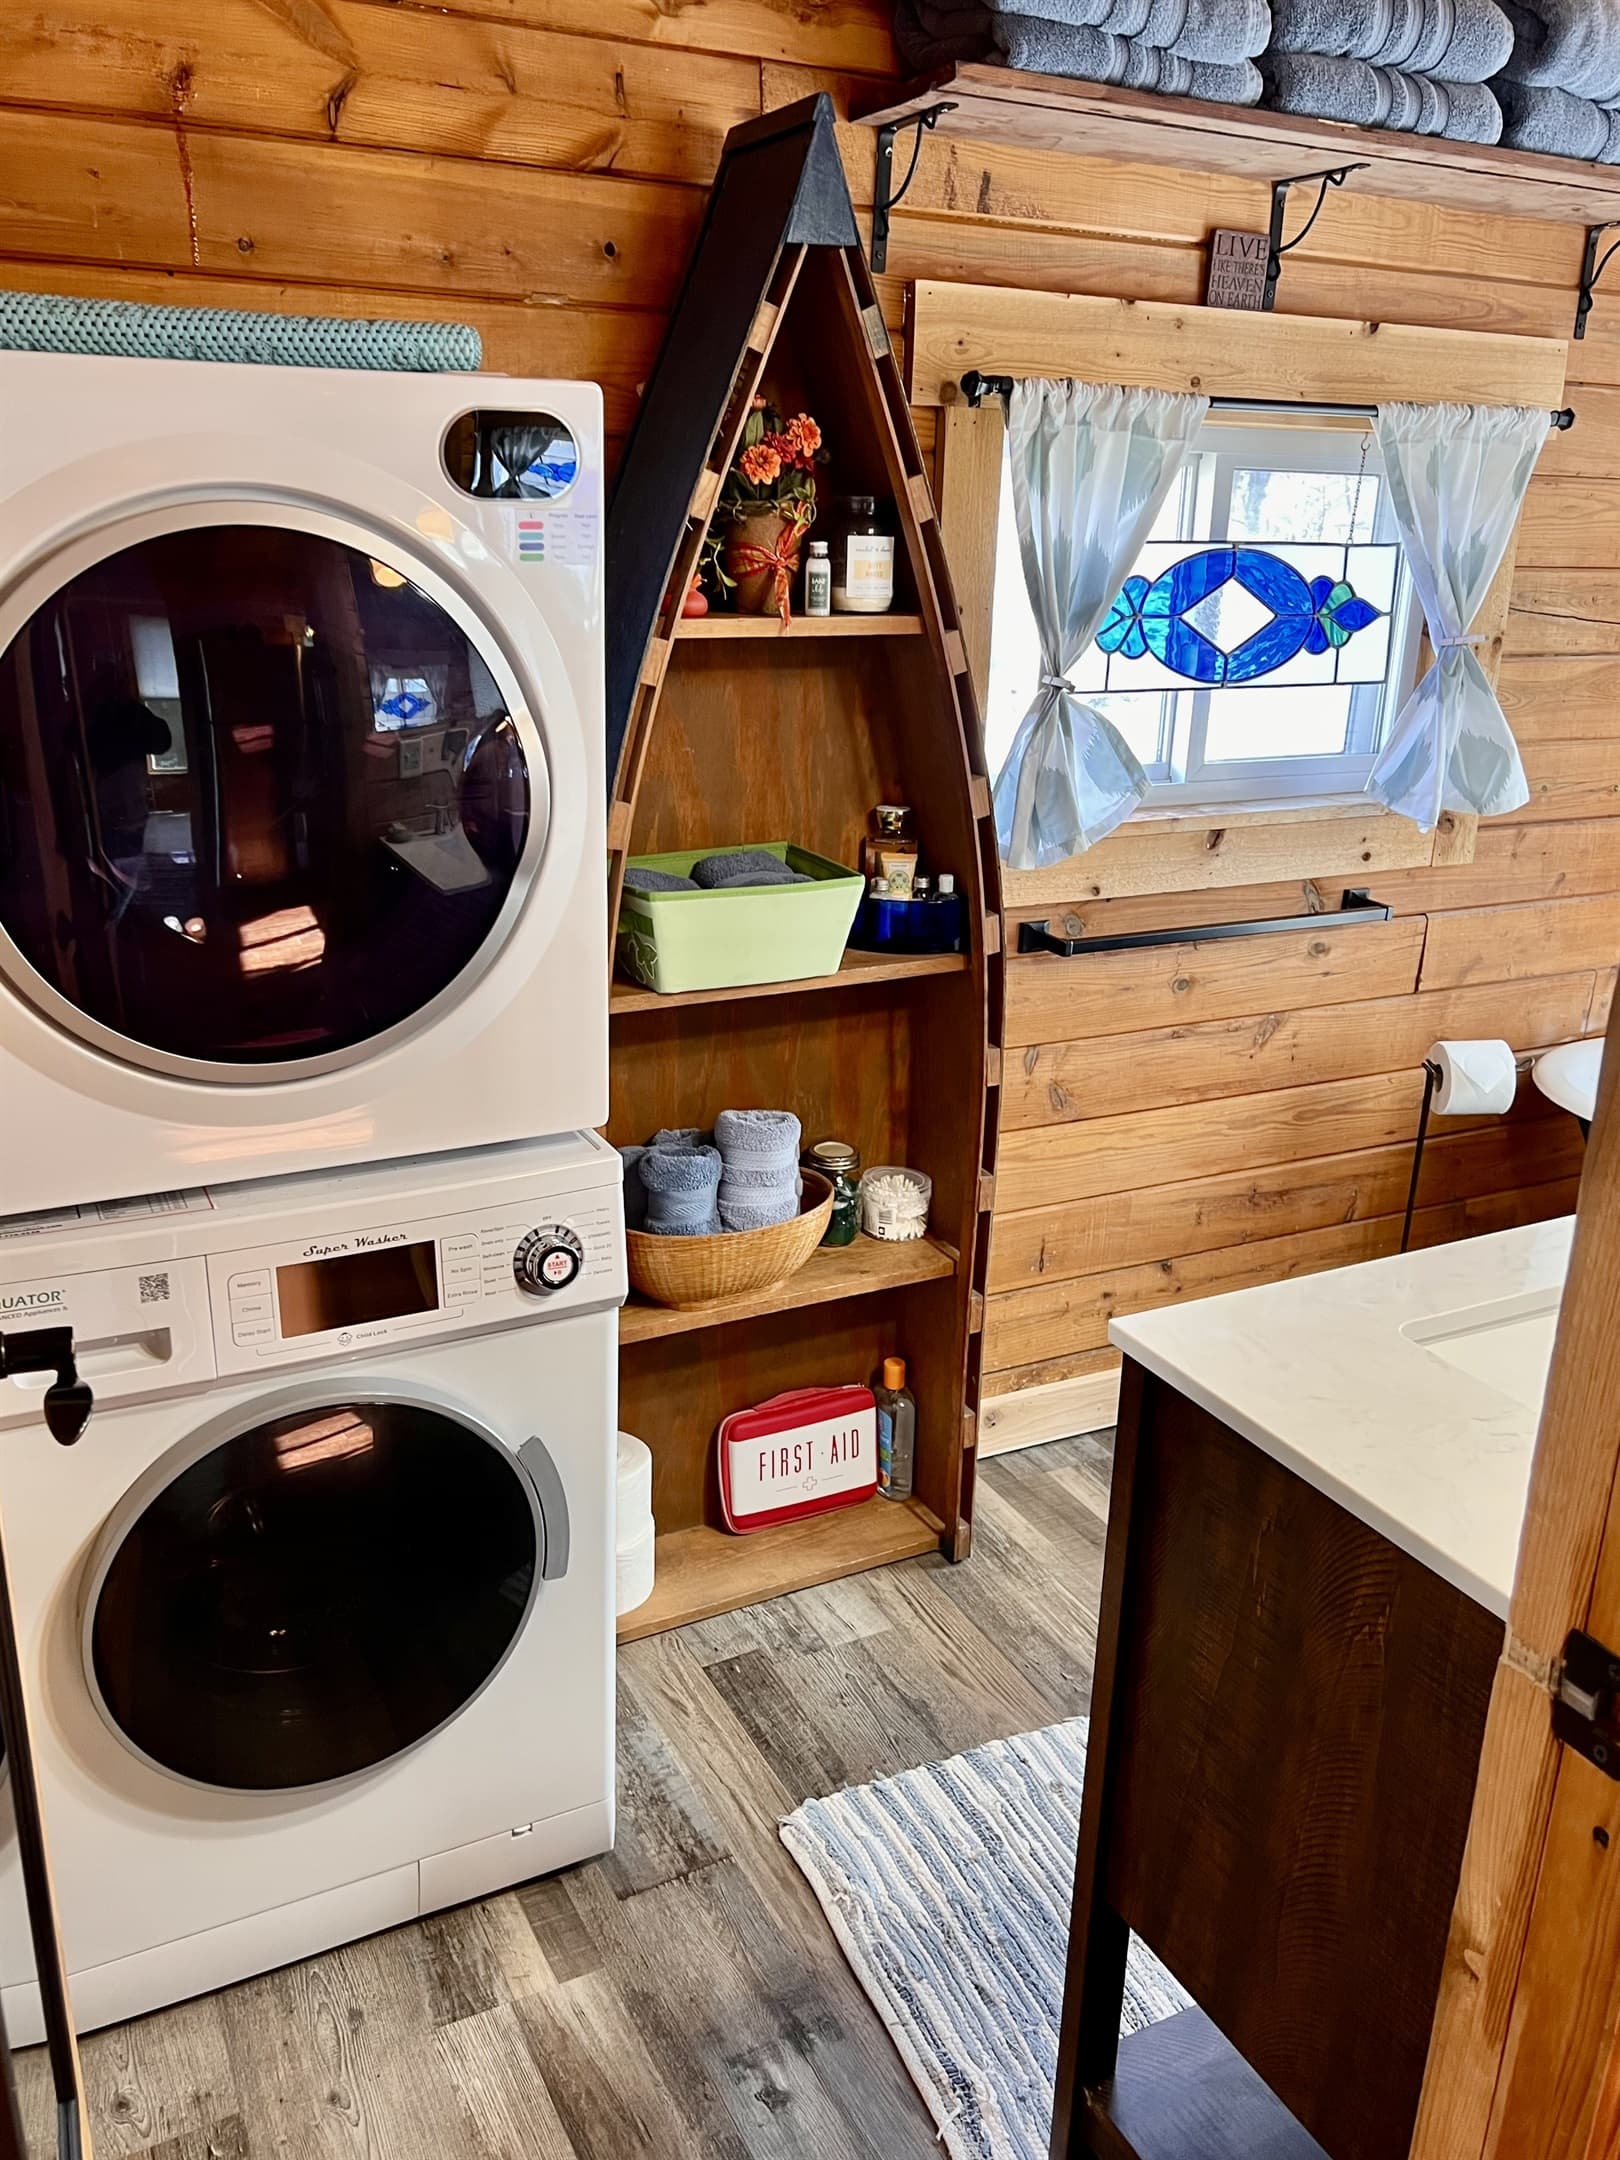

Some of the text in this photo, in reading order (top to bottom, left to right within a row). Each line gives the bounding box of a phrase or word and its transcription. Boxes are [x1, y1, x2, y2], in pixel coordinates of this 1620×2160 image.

[1216, 233, 1268, 260] LIVE
[1213, 258, 1232, 273] LIKE
[1211, 274, 1264, 292] HEAVEN
[1208, 289, 1262, 310] ON EARTH
[303, 1232, 408, 1257] Super Washer
[547, 1260, 567, 1268] START
[237, 1281, 261, 1289] Memory
[0, 1290, 62, 1310] UATOR
[356, 1329, 388, 1340] Child Lock
[759, 1428, 860, 1482] FIRST AID
